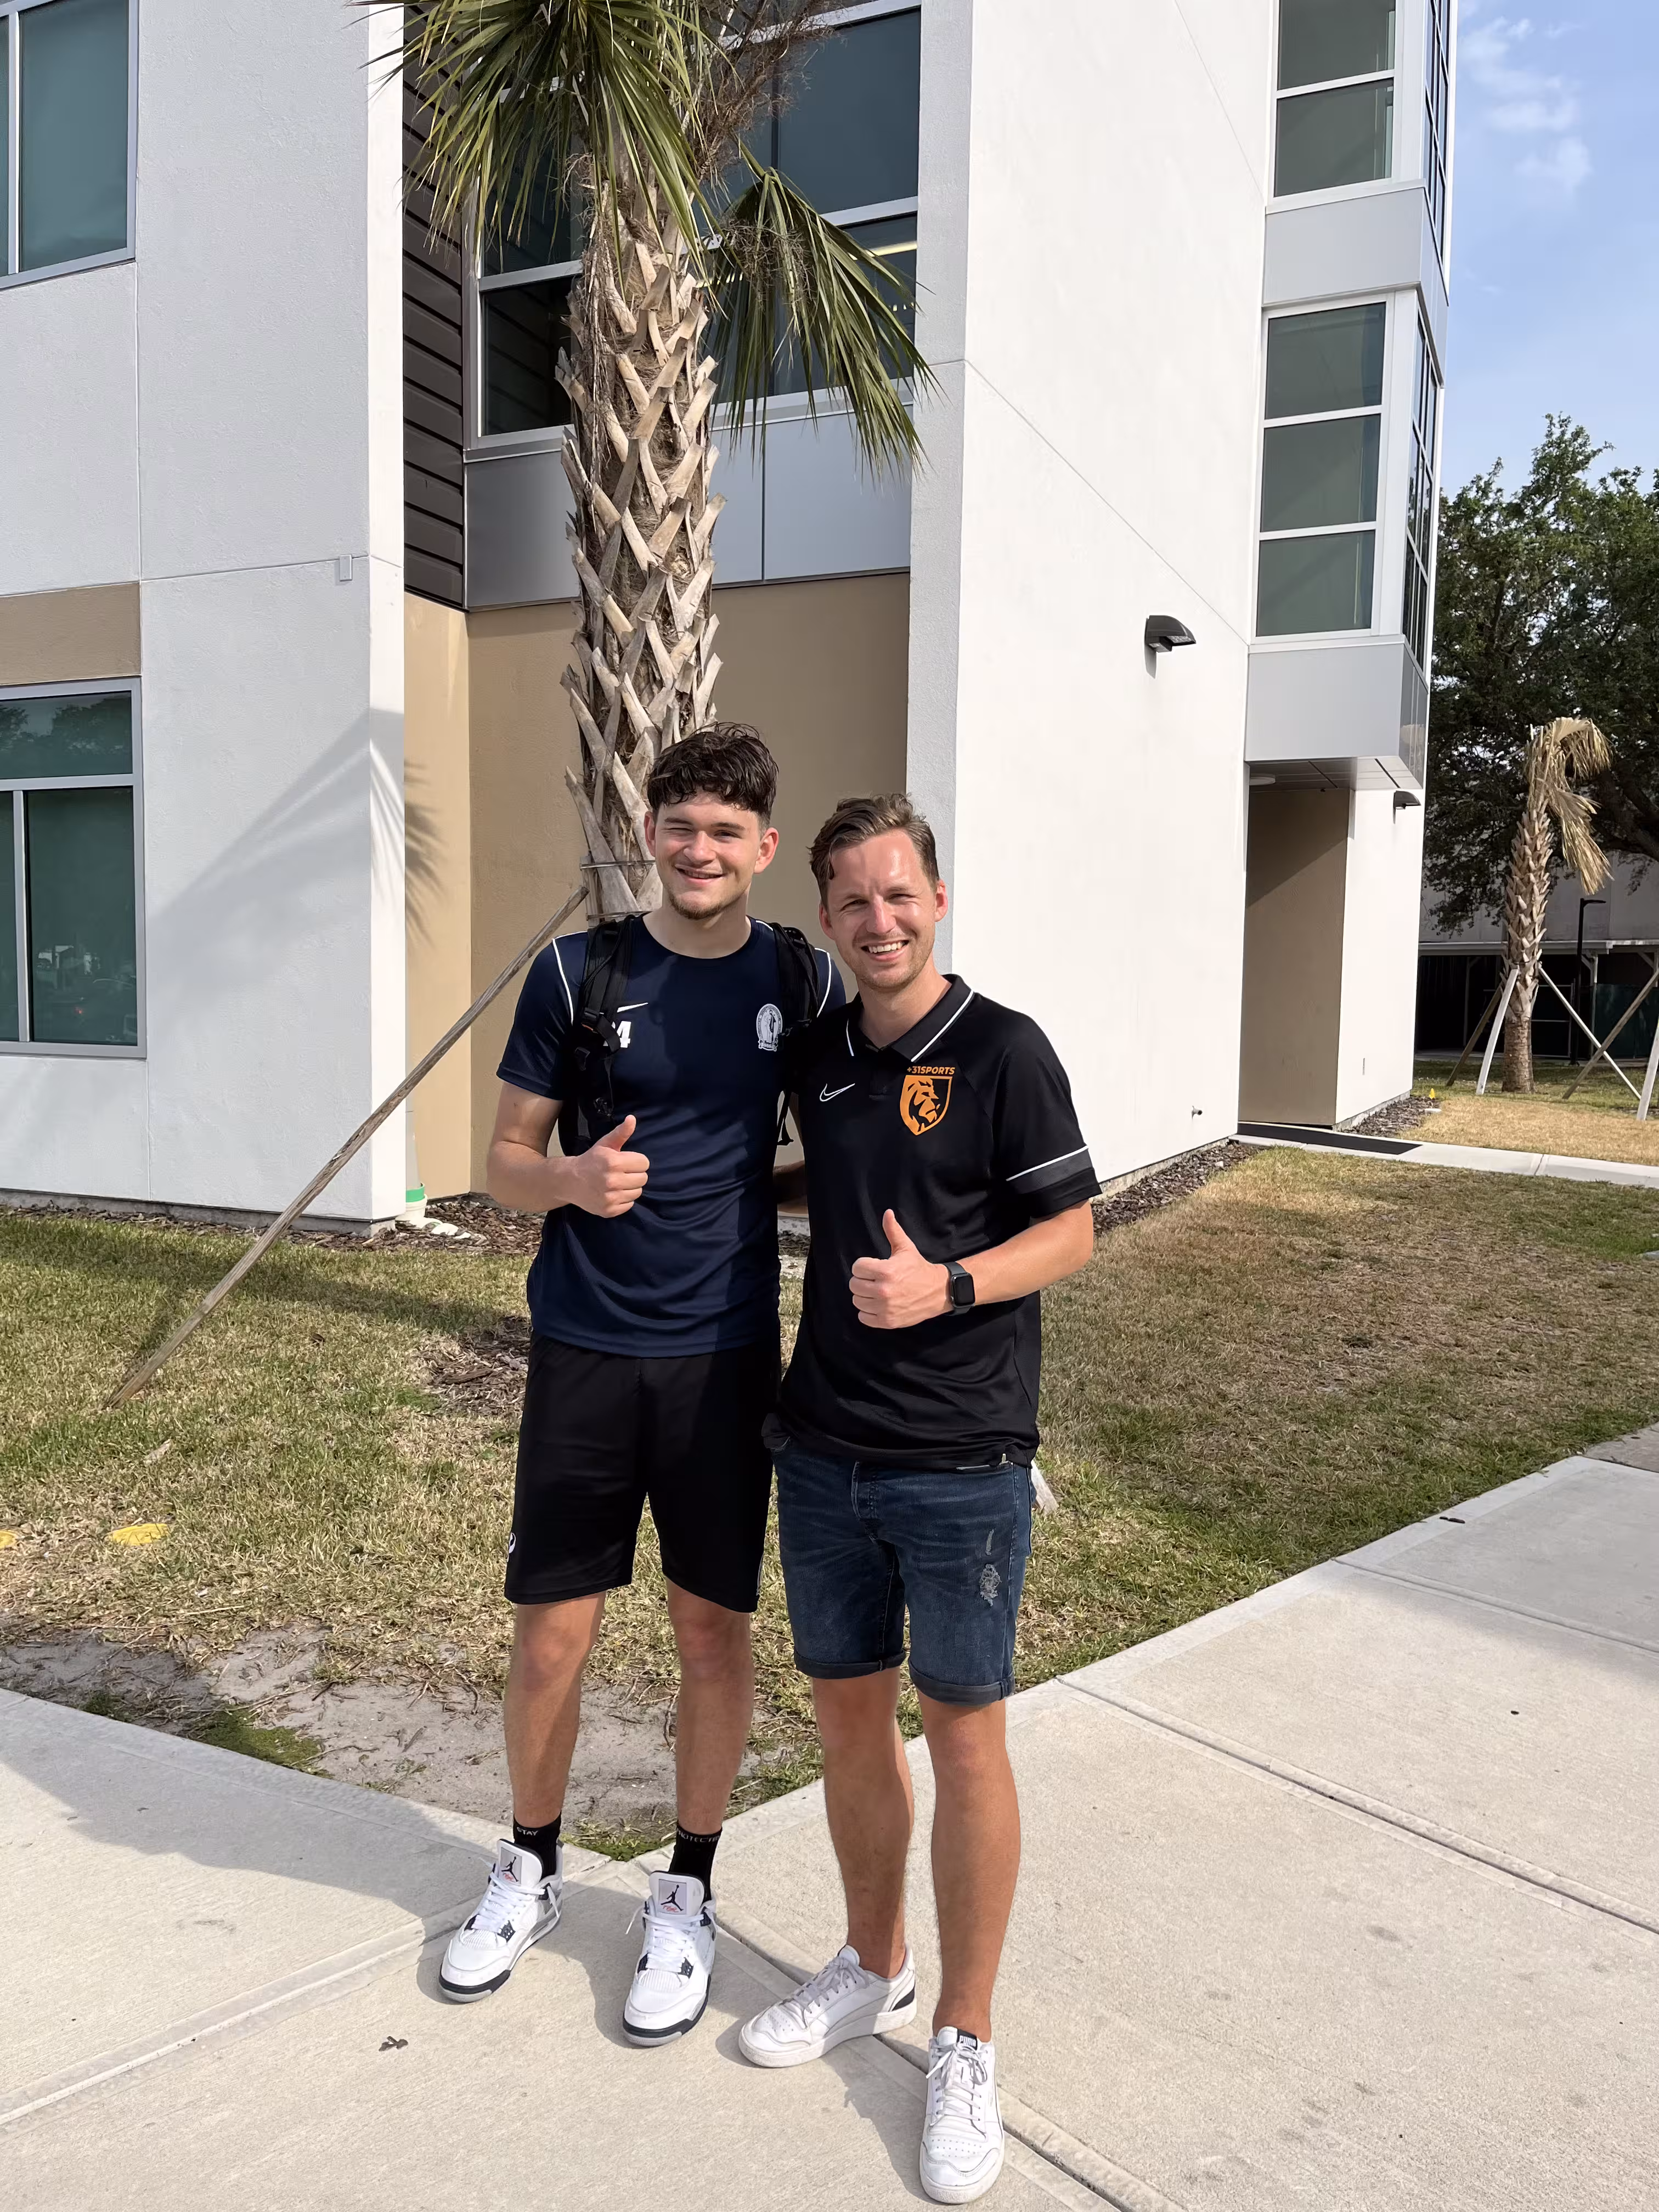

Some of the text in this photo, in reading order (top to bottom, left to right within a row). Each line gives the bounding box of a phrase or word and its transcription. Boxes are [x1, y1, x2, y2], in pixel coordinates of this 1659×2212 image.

[603, 1020, 631, 1048] 4
[907, 1066, 955, 1075] +31SPORTS
[516, 1826, 538, 1836] STAY
